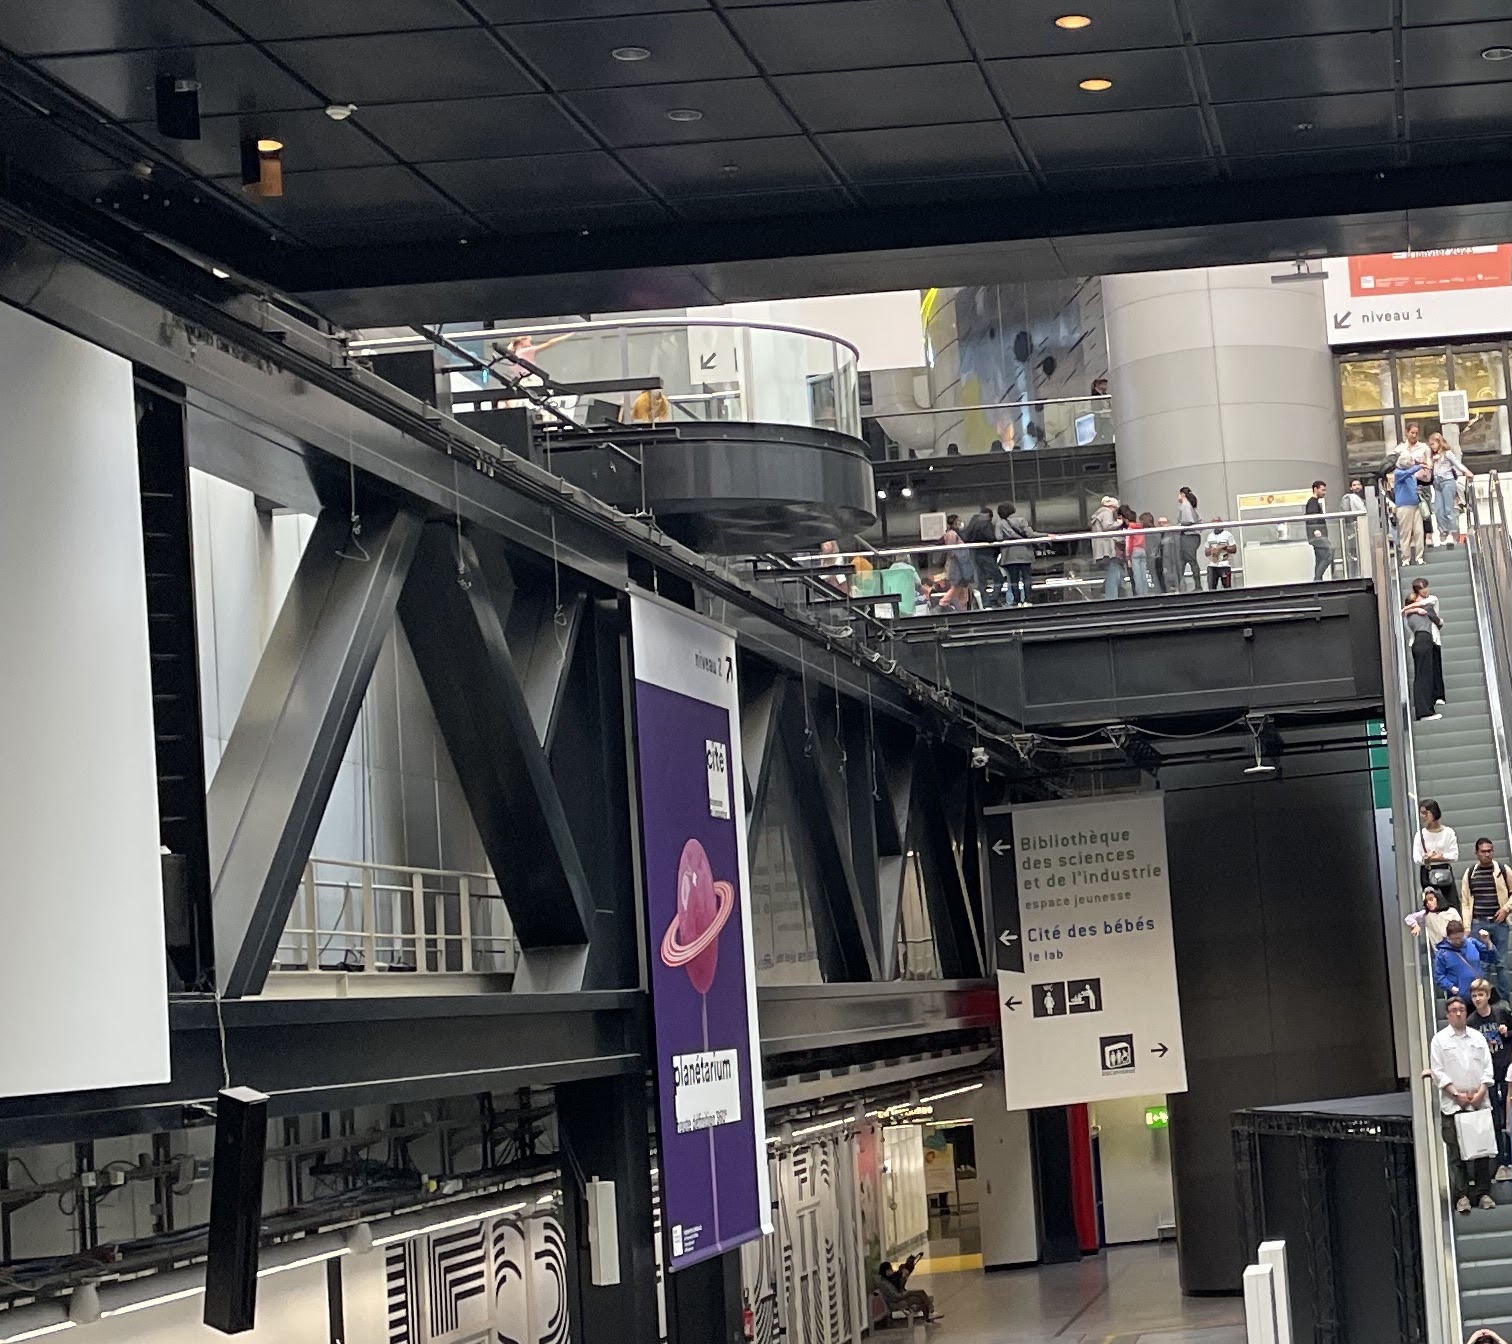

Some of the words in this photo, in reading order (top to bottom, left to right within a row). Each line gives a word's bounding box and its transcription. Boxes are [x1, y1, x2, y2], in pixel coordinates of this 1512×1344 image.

[1361, 309, 1410, 324] niveau
[1416, 308, 1424, 320] 1
[695, 648, 717, 675] niveau
[705, 742, 725, 773] cité
[1020, 829, 1131, 852] Bibliothèque
[1022, 856, 1052, 870] des
[1058, 848, 1135, 867] sciences
[1023, 876, 1041, 890] et
[1046, 872, 1067, 887] de
[1072, 865, 1162, 885] l'industrie
[1025, 895, 1070, 910] espace
[1074, 890, 1132, 907] jeunesse
[1028, 924, 1061, 943] Cité
[1067, 922, 1097, 938] des
[1103, 916, 1155, 935] bébés
[1028, 951, 1041, 962] le
[1044, 949, 1064, 961] lab
